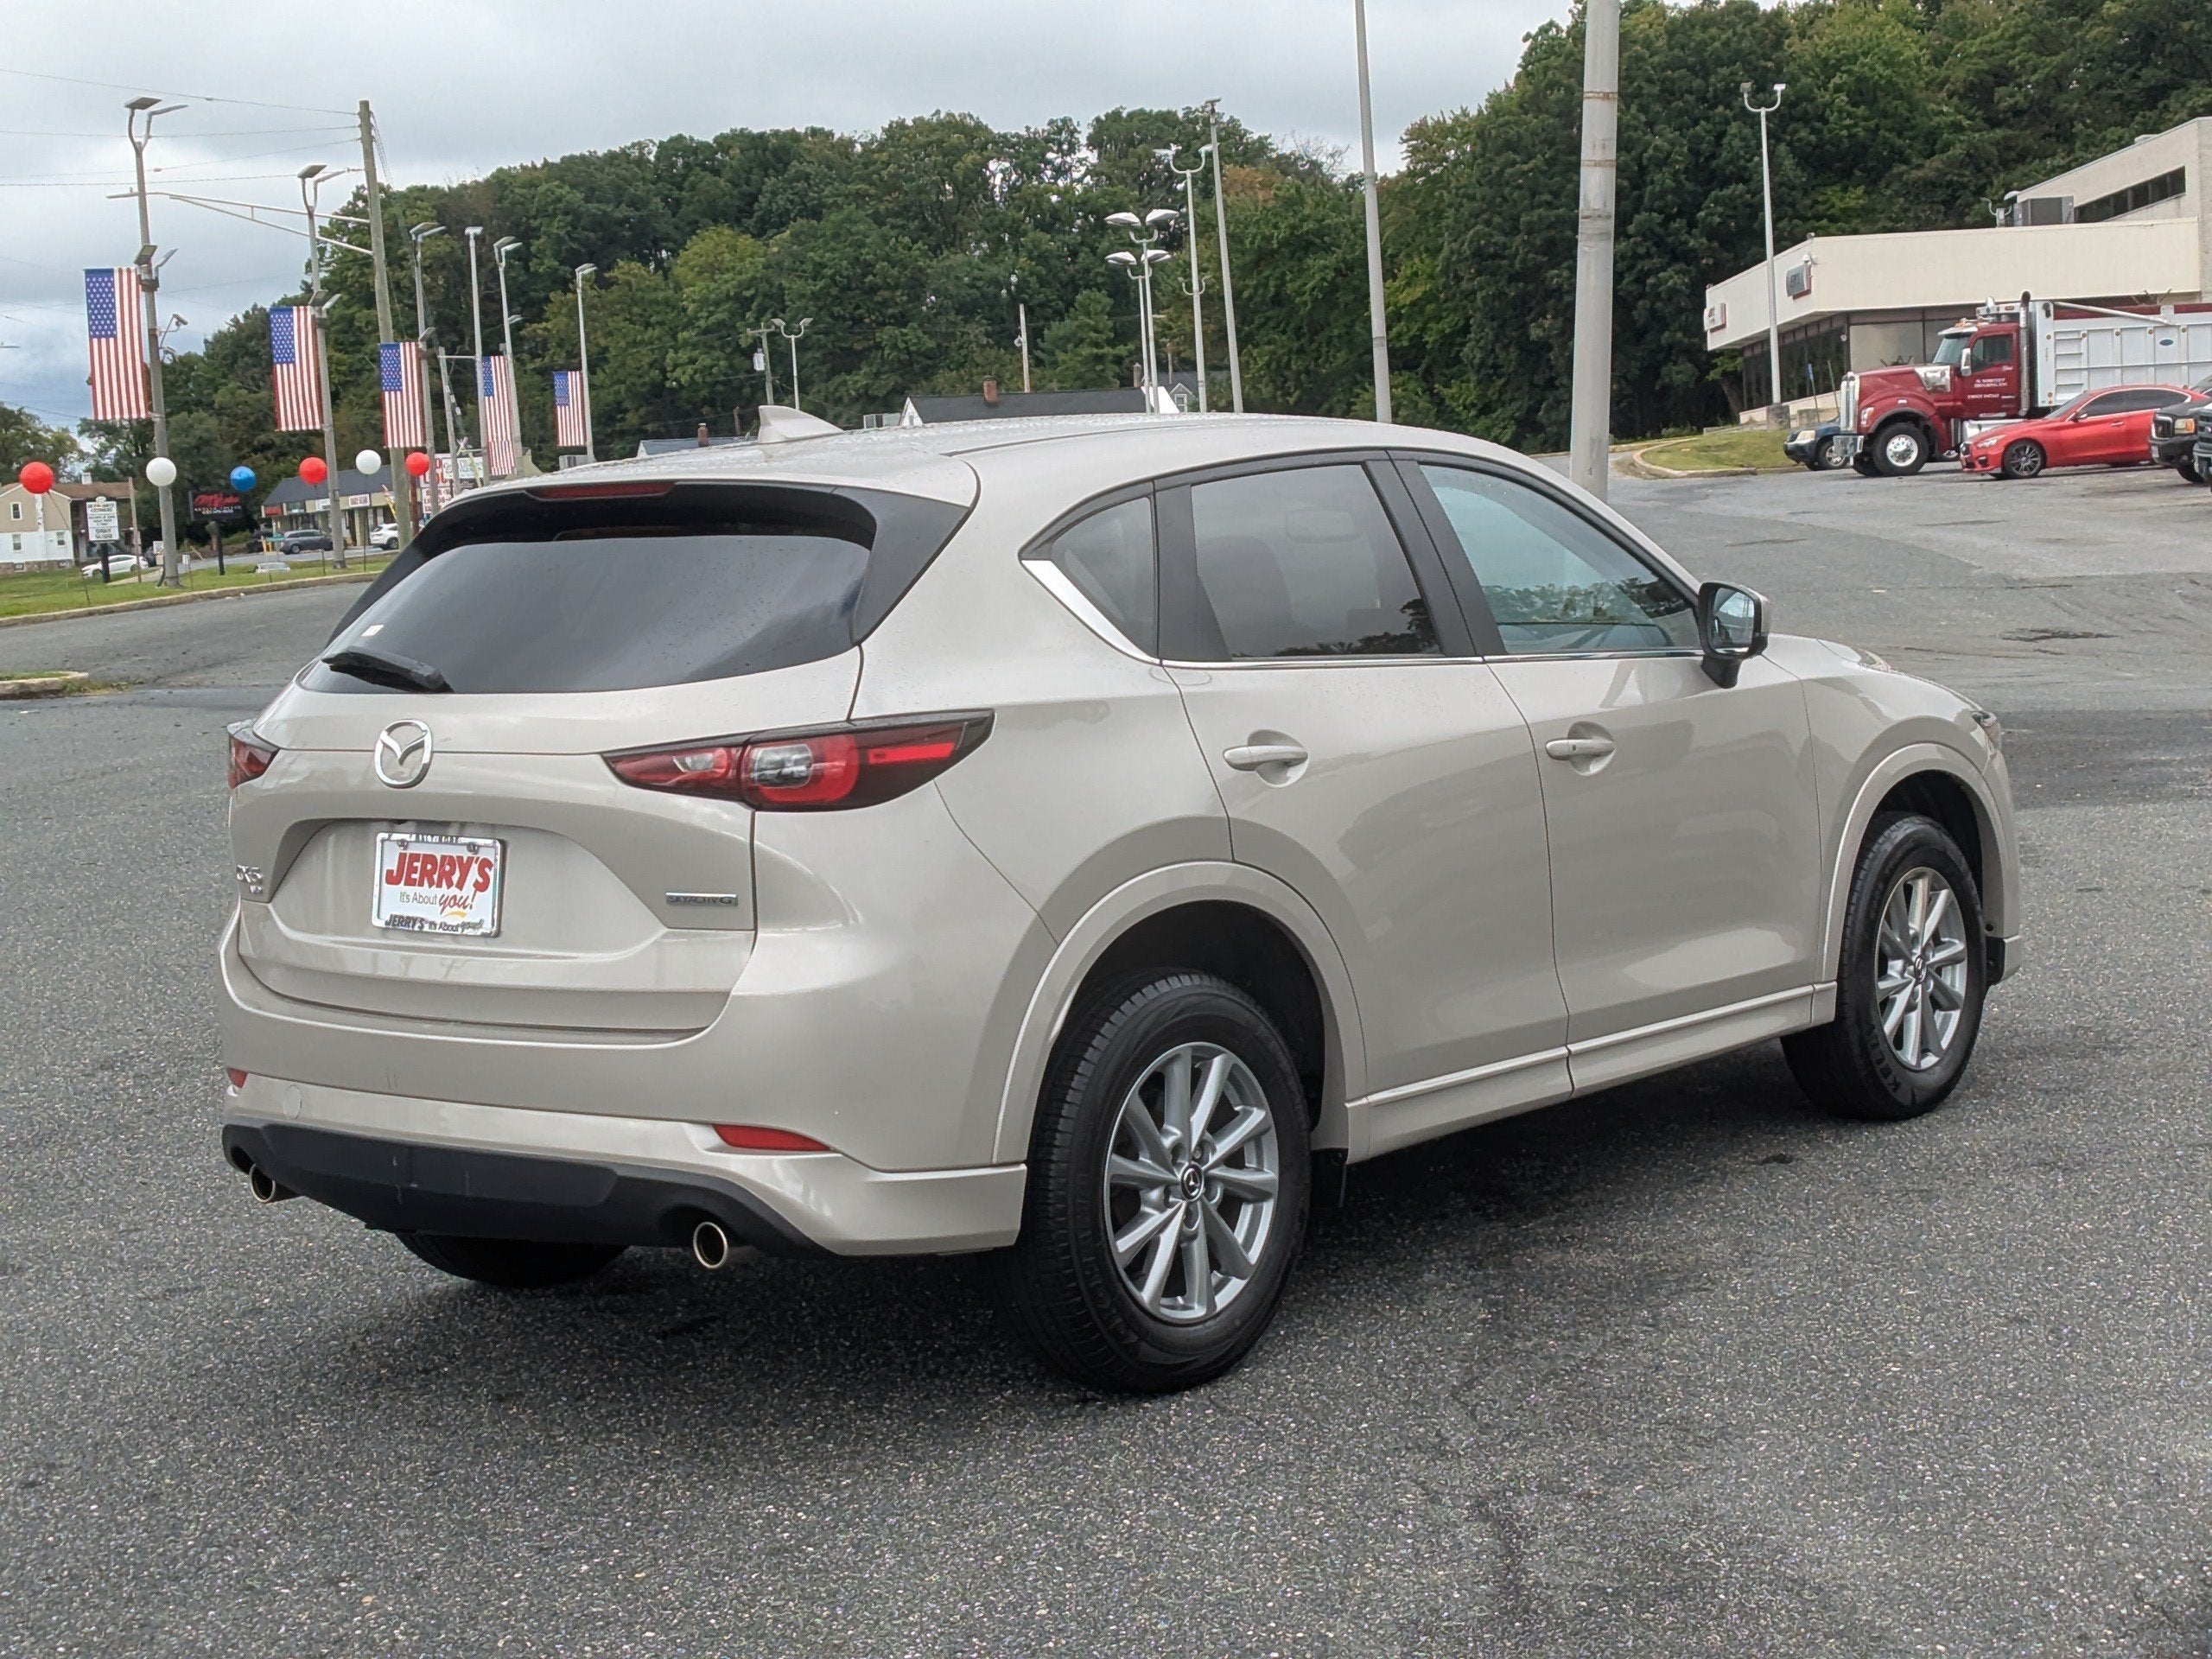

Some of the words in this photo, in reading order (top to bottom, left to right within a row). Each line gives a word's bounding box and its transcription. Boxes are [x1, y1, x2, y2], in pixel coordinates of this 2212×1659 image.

[385, 852, 493, 893] JERRY'S
[399, 891, 410, 904] It's
[412, 893, 437, 906] About
[438, 890, 478, 915] you!
